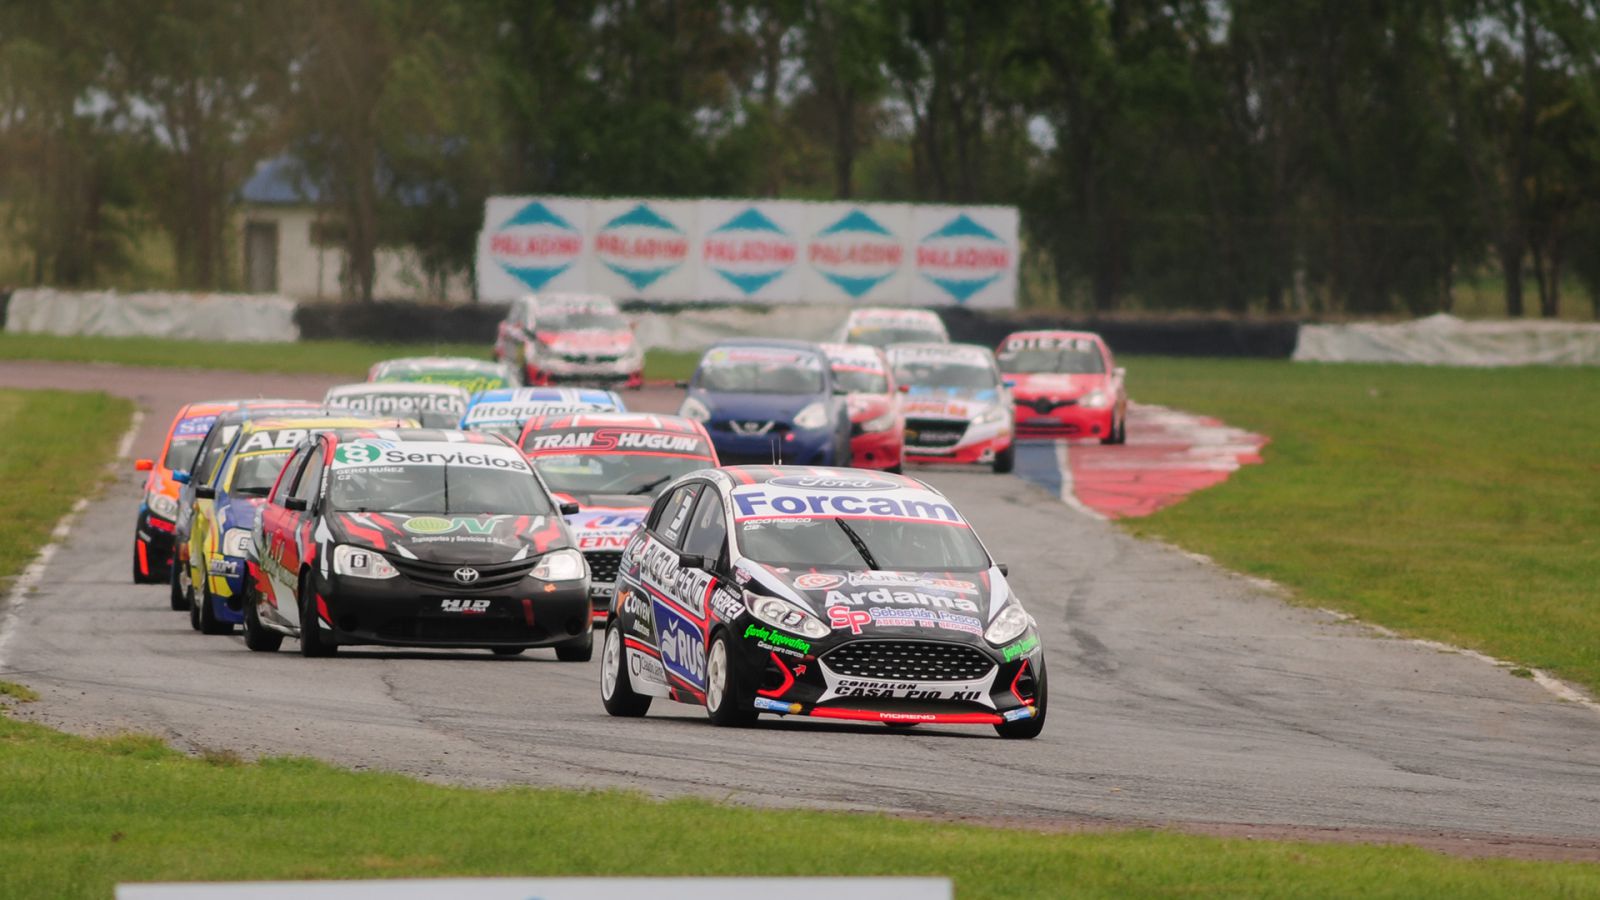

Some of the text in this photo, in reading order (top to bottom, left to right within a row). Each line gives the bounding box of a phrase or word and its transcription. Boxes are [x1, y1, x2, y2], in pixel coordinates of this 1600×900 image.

[386, 449, 527, 471] Servicios
[798, 476, 874, 489] Ford
[732, 492, 960, 522] Forcam
[456, 535, 486, 543] Servicios
[352, 555, 366, 568] 6
[824, 588, 980, 613] Ardama
[828, 606, 872, 635] SP
[871, 607, 937, 621] Sebastián
[876, 618, 915, 627] ASESOR
[677, 629, 706, 681] RUS
[838, 680, 918, 690] CORRALON
[834, 686, 982, 700] CASA PIO XII
[879, 712, 936, 720] MORENO
